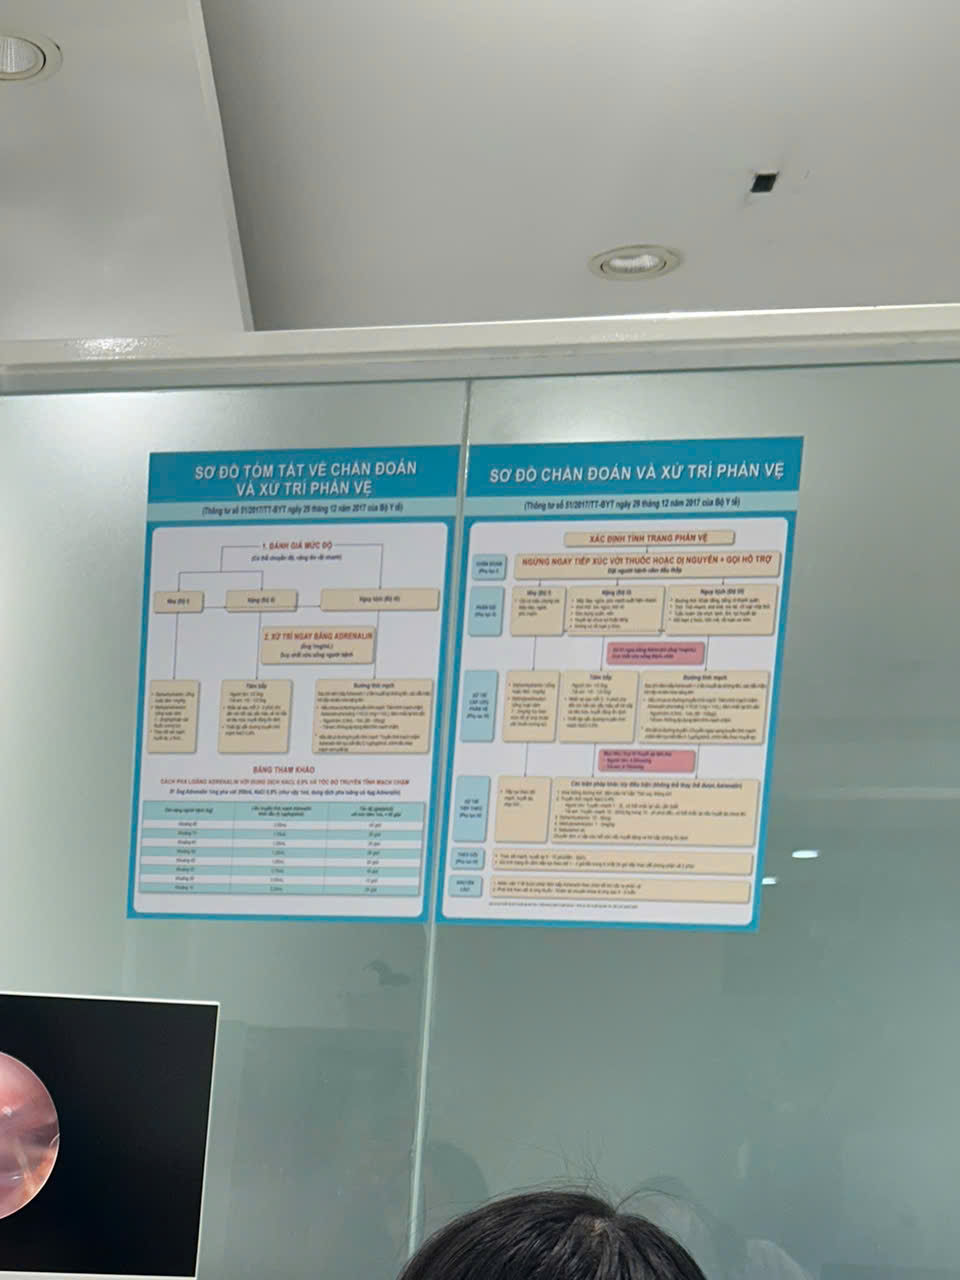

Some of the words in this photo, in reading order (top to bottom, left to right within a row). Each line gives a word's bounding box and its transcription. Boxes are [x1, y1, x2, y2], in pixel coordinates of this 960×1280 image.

[243, 461, 273, 478] TÓM
[375, 457, 417, 475] ĐOÁN
[587, 463, 631, 480] ĐOÁN
[636, 462, 656, 479] VÀ
[688, 460, 712, 478] TRÍ
